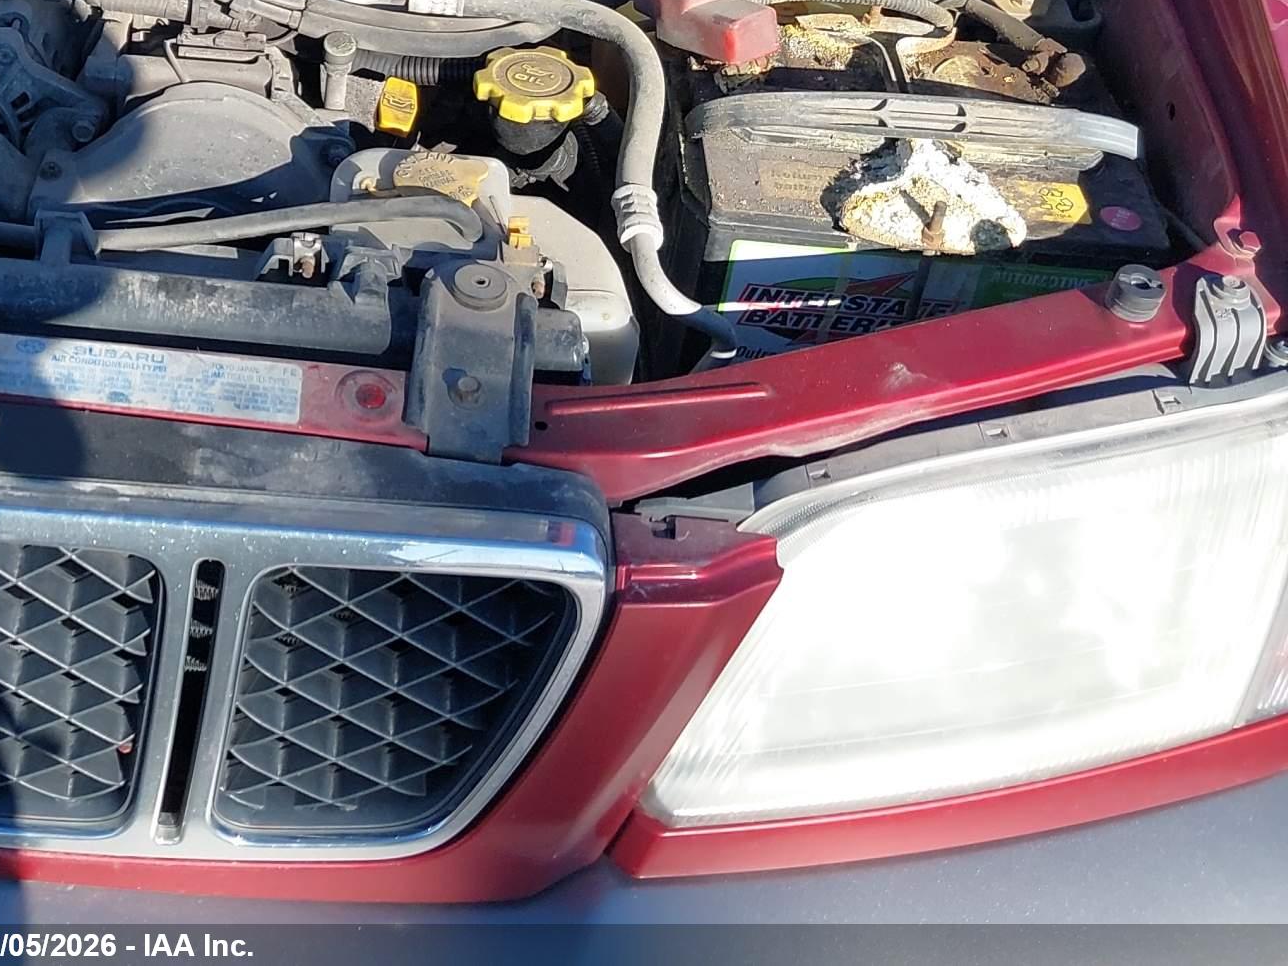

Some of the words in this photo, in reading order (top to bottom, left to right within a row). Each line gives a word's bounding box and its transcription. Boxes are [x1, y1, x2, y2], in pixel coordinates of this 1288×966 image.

[514, 73, 545, 86] OIL
[395, 152, 454, 178] COOLANT
[72, 345, 166, 364] SUBARU
